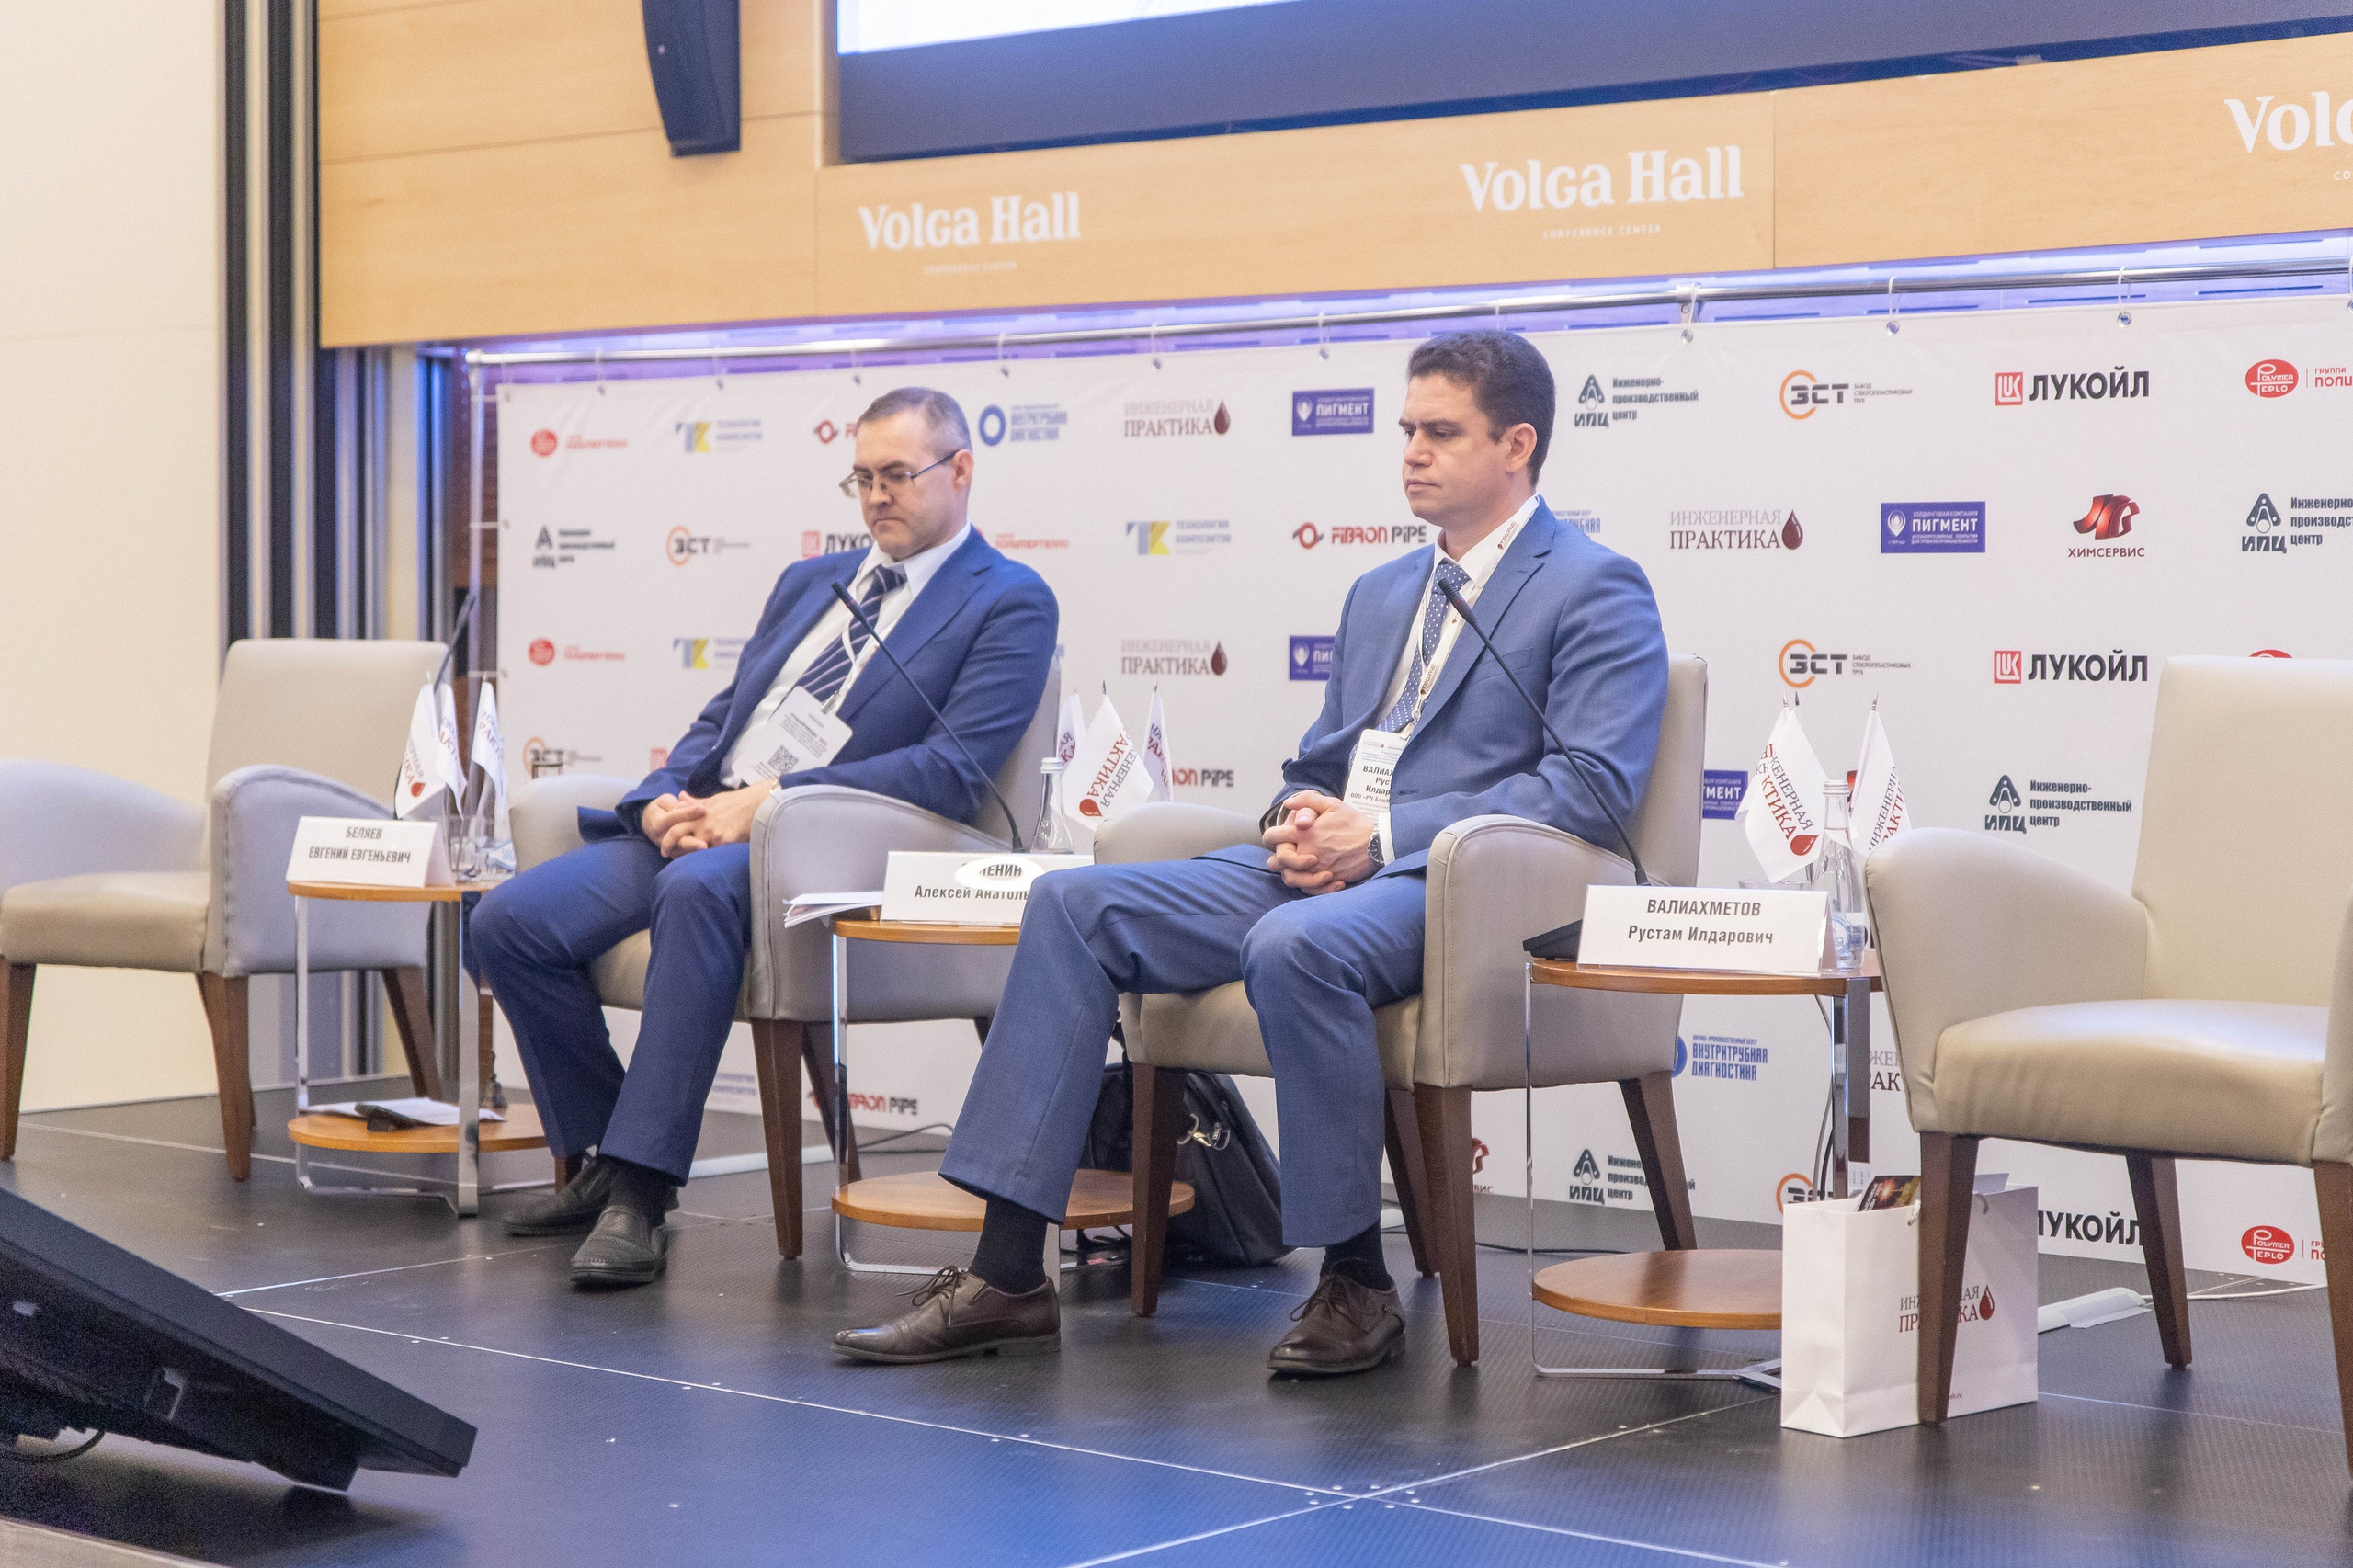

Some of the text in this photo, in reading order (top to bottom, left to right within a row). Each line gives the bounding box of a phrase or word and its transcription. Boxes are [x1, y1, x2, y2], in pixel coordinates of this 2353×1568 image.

[1459, 145, 1745, 212] Volga Hall
[858, 190, 1082, 252] Volga Hall
[1542, 223, 1662, 240] CONFERENCE CENTER
[2029, 365, 2150, 401] ЛУКОЙЛ
[1315, 403, 1369, 416] ПИГМЕНТ
[1612, 409, 1638, 422] центр
[1123, 417, 1213, 437] ПРАКТИКА
[1670, 509, 1781, 527] ИНЖЕНЕРНАЯ
[1912, 517, 1979, 532] ПИГМЕНТ
[825, 531, 874, 554] ЛУКО
[1670, 529, 1781, 550] ПРАКТИКА
[2242, 535, 2287, 553] ИПЦ
[2290, 534, 2323, 546] центр
[2068, 547, 2146, 558] ХИМСЕРВИС
[1121, 656, 1211, 675] ПРАКТИКА
[2028, 649, 2148, 682] ЛУКОЙЛ
[1086, 733, 1129, 797] АКТИКА
[1375, 777, 1390, 786] Рус
[2030, 780, 2092, 794] Инженерно-
[1365, 785, 1391, 797] Илдар
[1761, 774, 1798, 841] КТИКА
[2030, 798, 2132, 812] производственный
[1984, 814, 2028, 835] ИПЦ
[2030, 815, 2060, 828] центр
[346, 826, 382, 840] БЕЛЯЕВ
[309, 846, 411, 864] ЕВГЕНИЙ ЕВГЕНЬЕВИЧ
[915, 885, 1028, 901] Алексей Анатол
[1647, 899, 1761, 917] ВАЛИАХМЕТОВ
[1628, 925, 1774, 946] Рустам Илдарович
[1608, 1155, 1643, 1169] Инжене
[1608, 1188, 1633, 1201] центр
